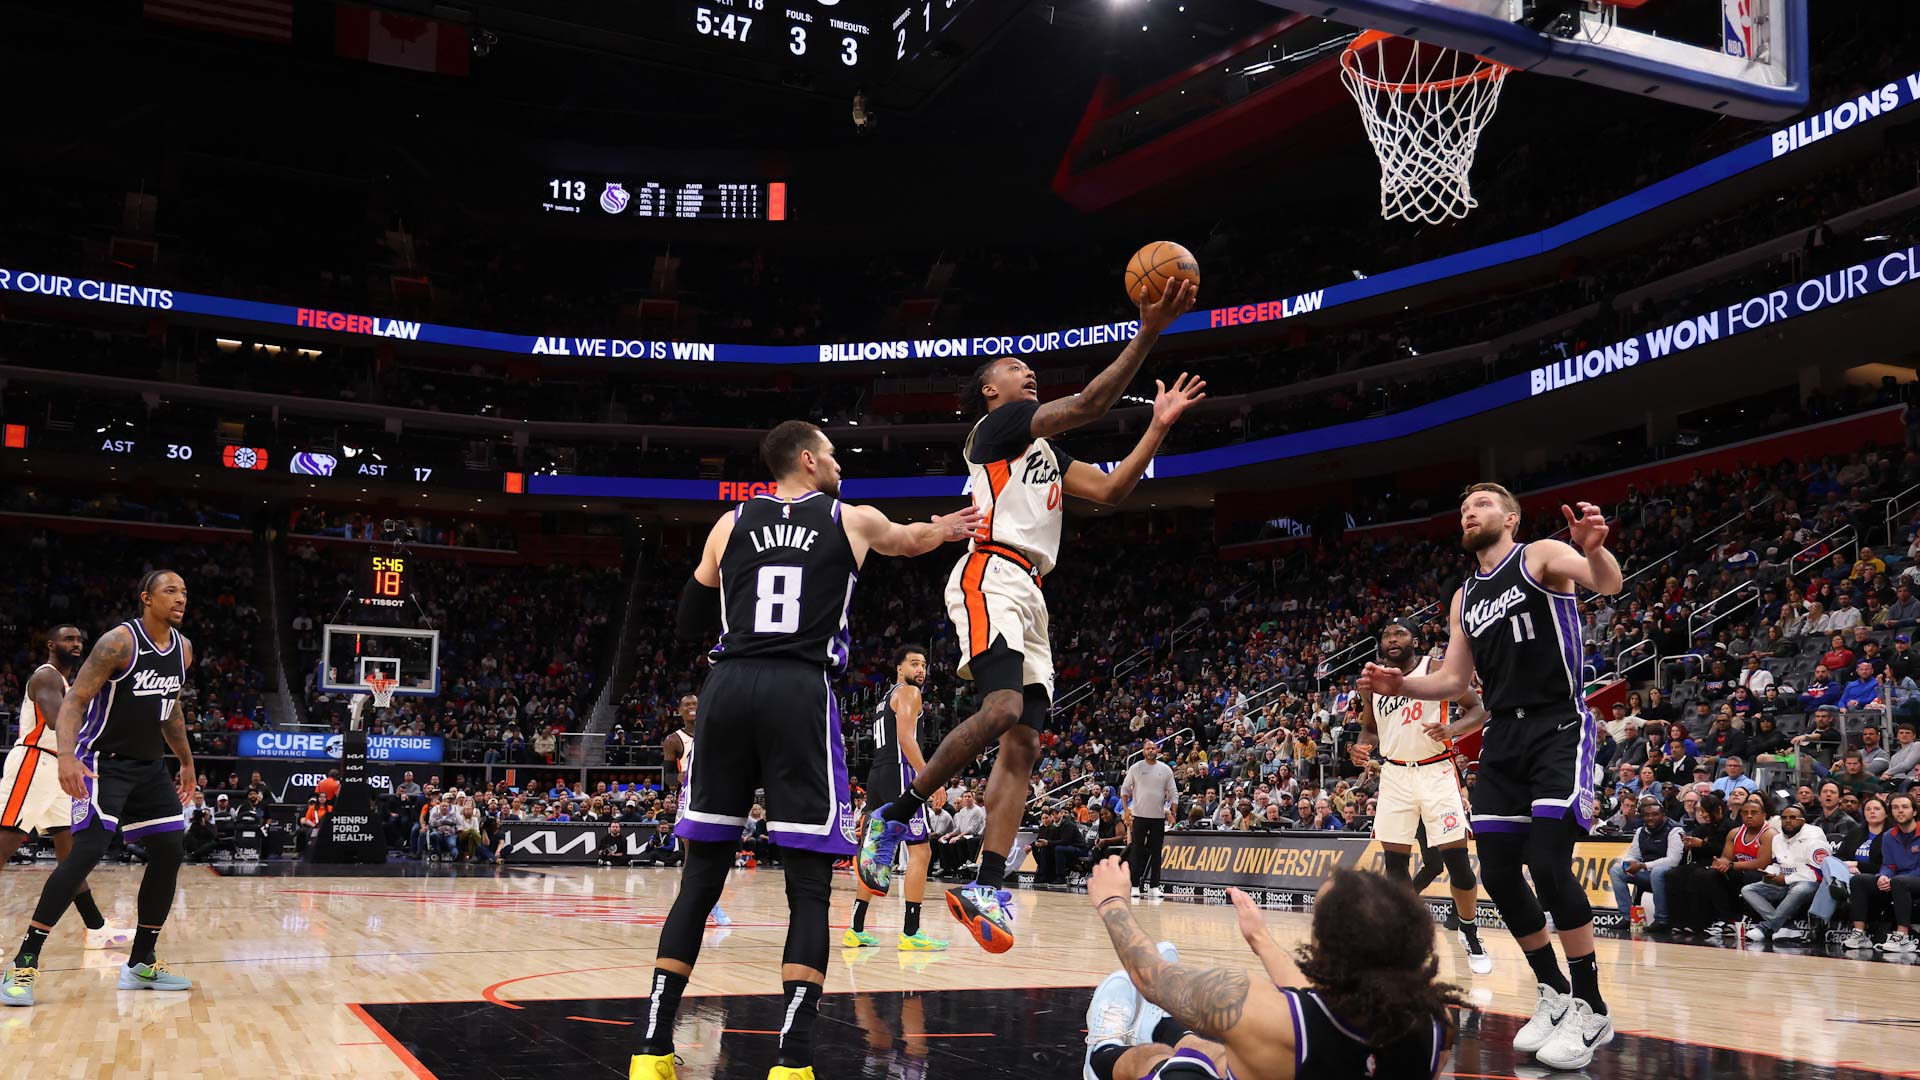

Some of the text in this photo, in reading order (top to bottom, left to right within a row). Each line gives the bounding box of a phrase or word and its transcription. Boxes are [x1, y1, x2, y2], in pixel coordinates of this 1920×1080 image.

[696, 7, 752, 43] 5:47
[786, 9, 813, 23] FOULS:
[830, 18, 870, 36] TIMEOUTS:
[923, 2, 930, 32] 1
[789, 26, 807, 56] 3
[841, 37, 858, 66] 3
[897, 28, 906, 60] 2
[1727, 39, 1743, 56] NBA
[1771, 83, 1898, 158] BILLIONS
[550, 179, 586, 201] 113
[17, 272, 73, 297] OUR
[78, 279, 174, 310] CLIENTS
[819, 320, 1139, 362] BILLIONS WON FOR OUR CLIENTS
[1530, 337, 1639, 396] BILLIONS
[1645, 310, 1719, 358] WON
[1728, 291, 1788, 335] FOR
[1796, 264, 1868, 312] OUR
[532, 336, 715, 361] ALL WE DO IS WIN
[101, 439, 192, 461] AST 30
[357, 463, 432, 482] AST 17
[750, 524, 819, 553] LAVINE
[373, 557, 403, 572] 5:46
[376, 571, 400, 595] 18
[754, 566, 804, 634] 8
[1465, 585, 1526, 638] Kings
[1510, 612, 1536, 643] 11
[132, 669, 181, 696] Kings
[1402, 701, 1423, 726] 28
[257, 734, 324, 750] CURE
[367, 736, 431, 749] OURTSIDE
[331, 816, 368, 825] HENRY
[333, 824, 360, 833] FORD
[332, 833, 374, 842] HEALTH
[1161, 845, 1232, 872] OAKLAND
[1232, 847, 1344, 877] UNIVERSITY
[1172, 886, 1196, 896] StockX
[1203, 887, 1227, 897] StockX
[1266, 892, 1293, 903] StockX
[1303, 894, 1315, 904] Sto
